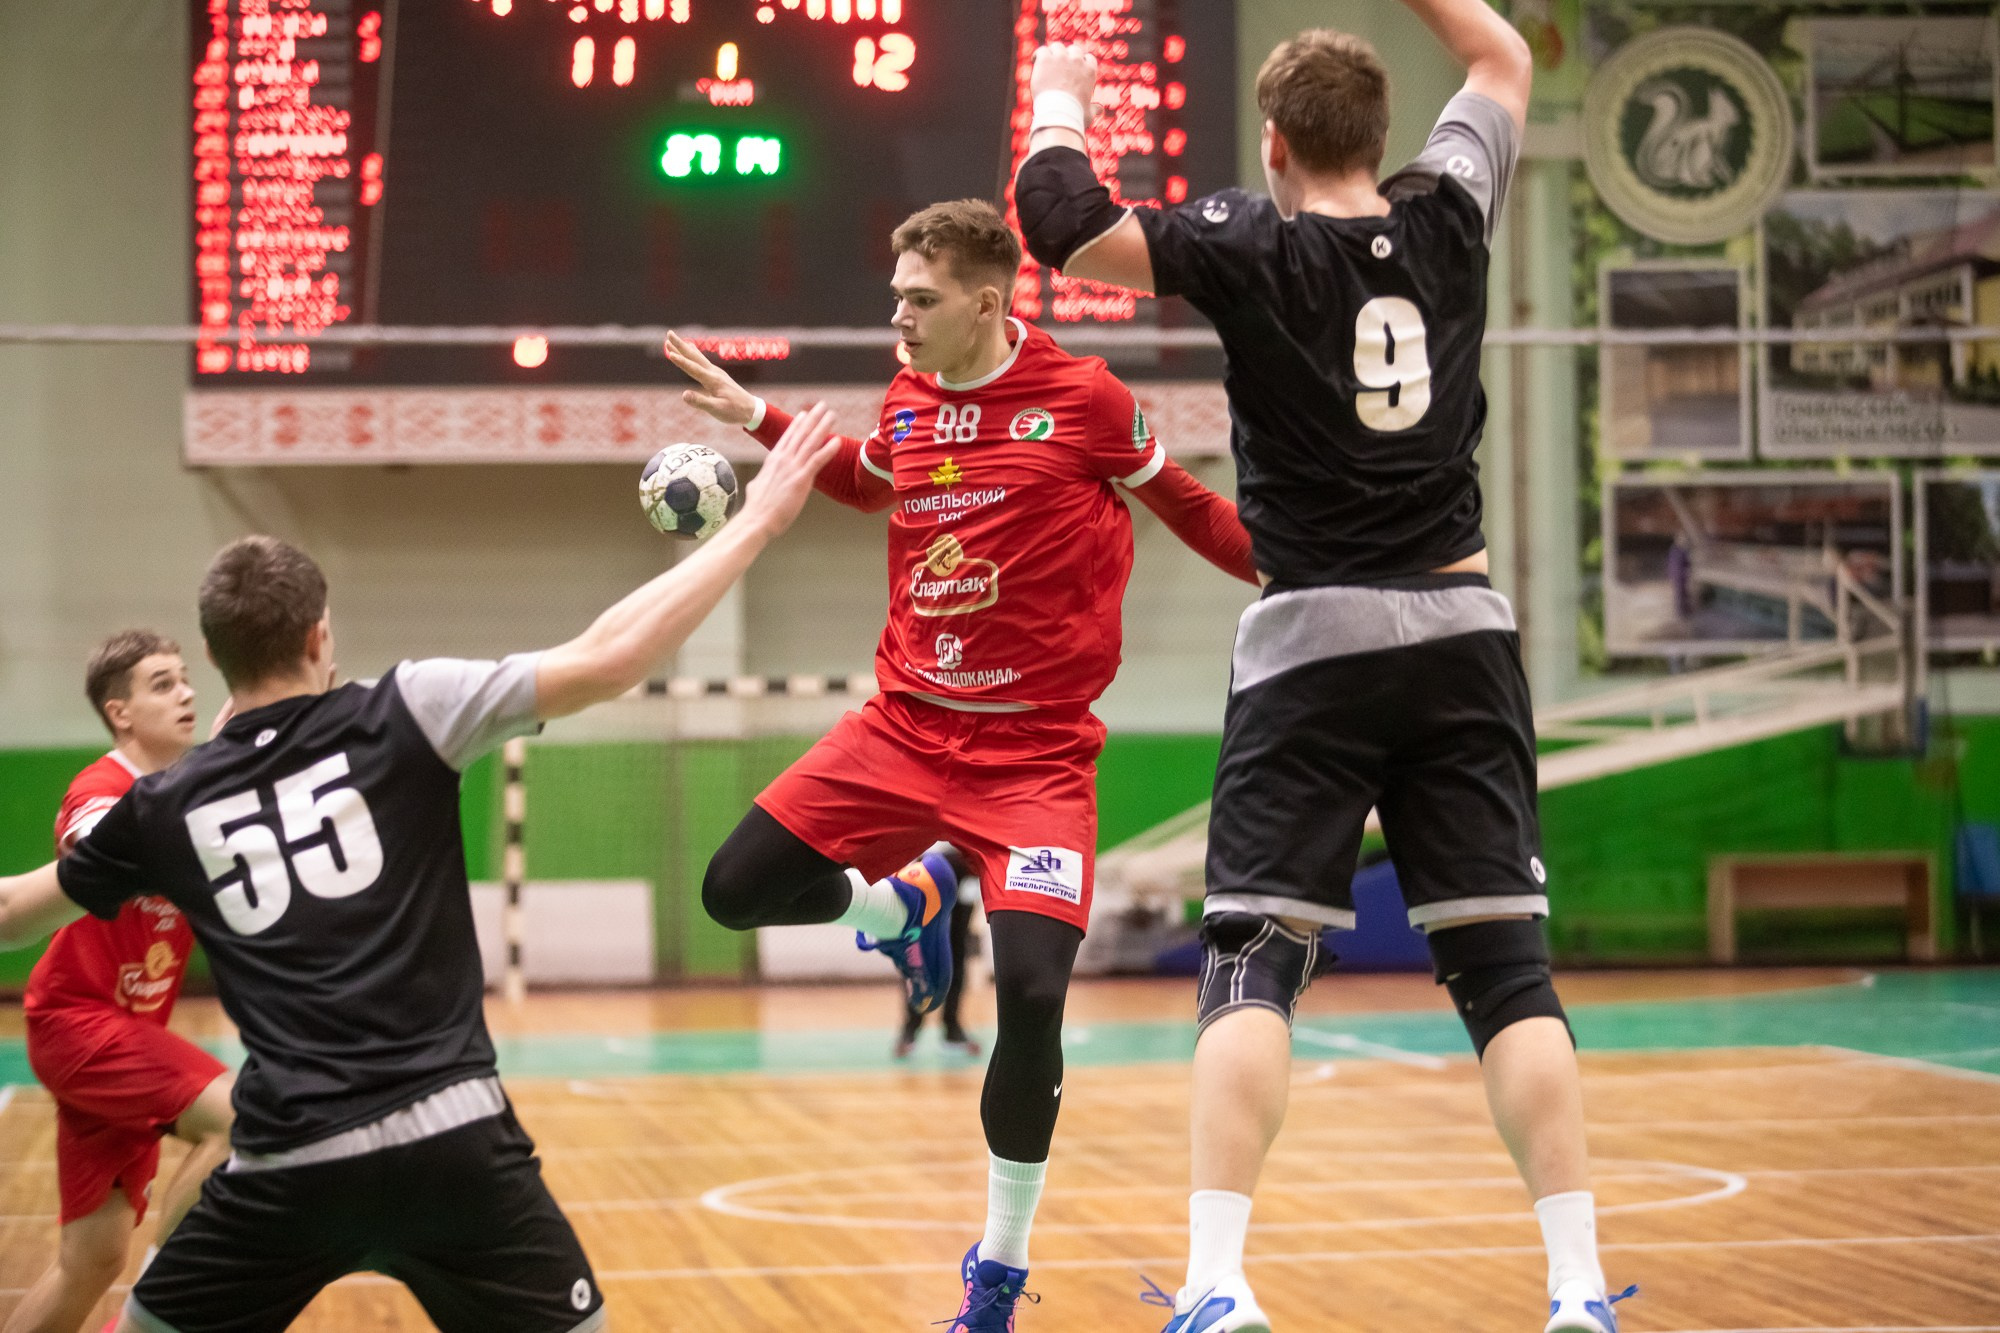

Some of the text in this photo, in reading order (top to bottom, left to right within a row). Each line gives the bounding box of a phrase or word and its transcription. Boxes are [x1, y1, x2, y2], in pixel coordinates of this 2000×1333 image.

[572, 36, 636, 88] 11
[853, 33, 916, 92] 12
[1353, 296, 1431, 432] 9
[933, 403, 981, 444] 98
[665, 447, 715, 475] SELECT
[904, 486, 1006, 514] ГОМЕЛЬСКИЙ
[911, 568, 988, 600] Спартак
[185, 752, 384, 936] 55
[1009, 881, 1077, 900] ГОМЕЛЬРЕМСТРОЙ
